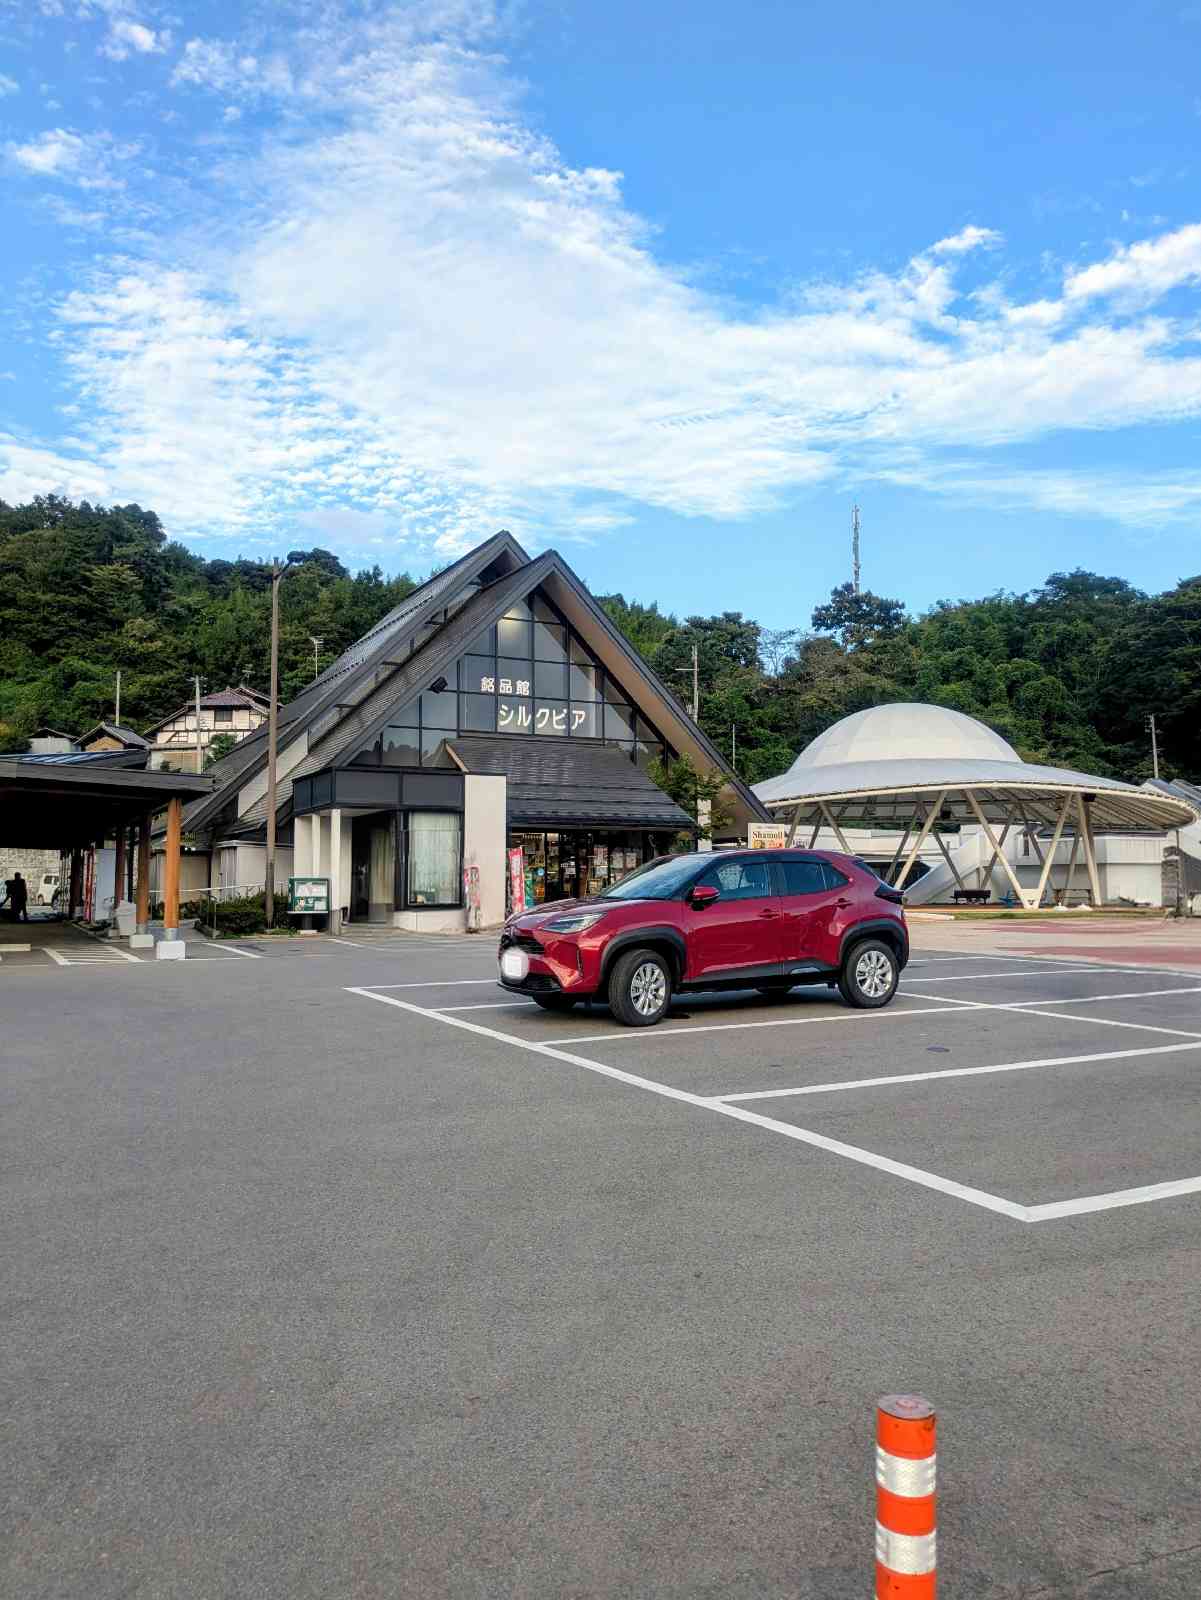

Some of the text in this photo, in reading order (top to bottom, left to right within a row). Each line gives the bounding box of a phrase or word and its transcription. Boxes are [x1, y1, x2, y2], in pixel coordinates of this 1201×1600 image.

[480, 676, 530, 696] 銘品館
[498, 704, 586, 730] シルクピア
